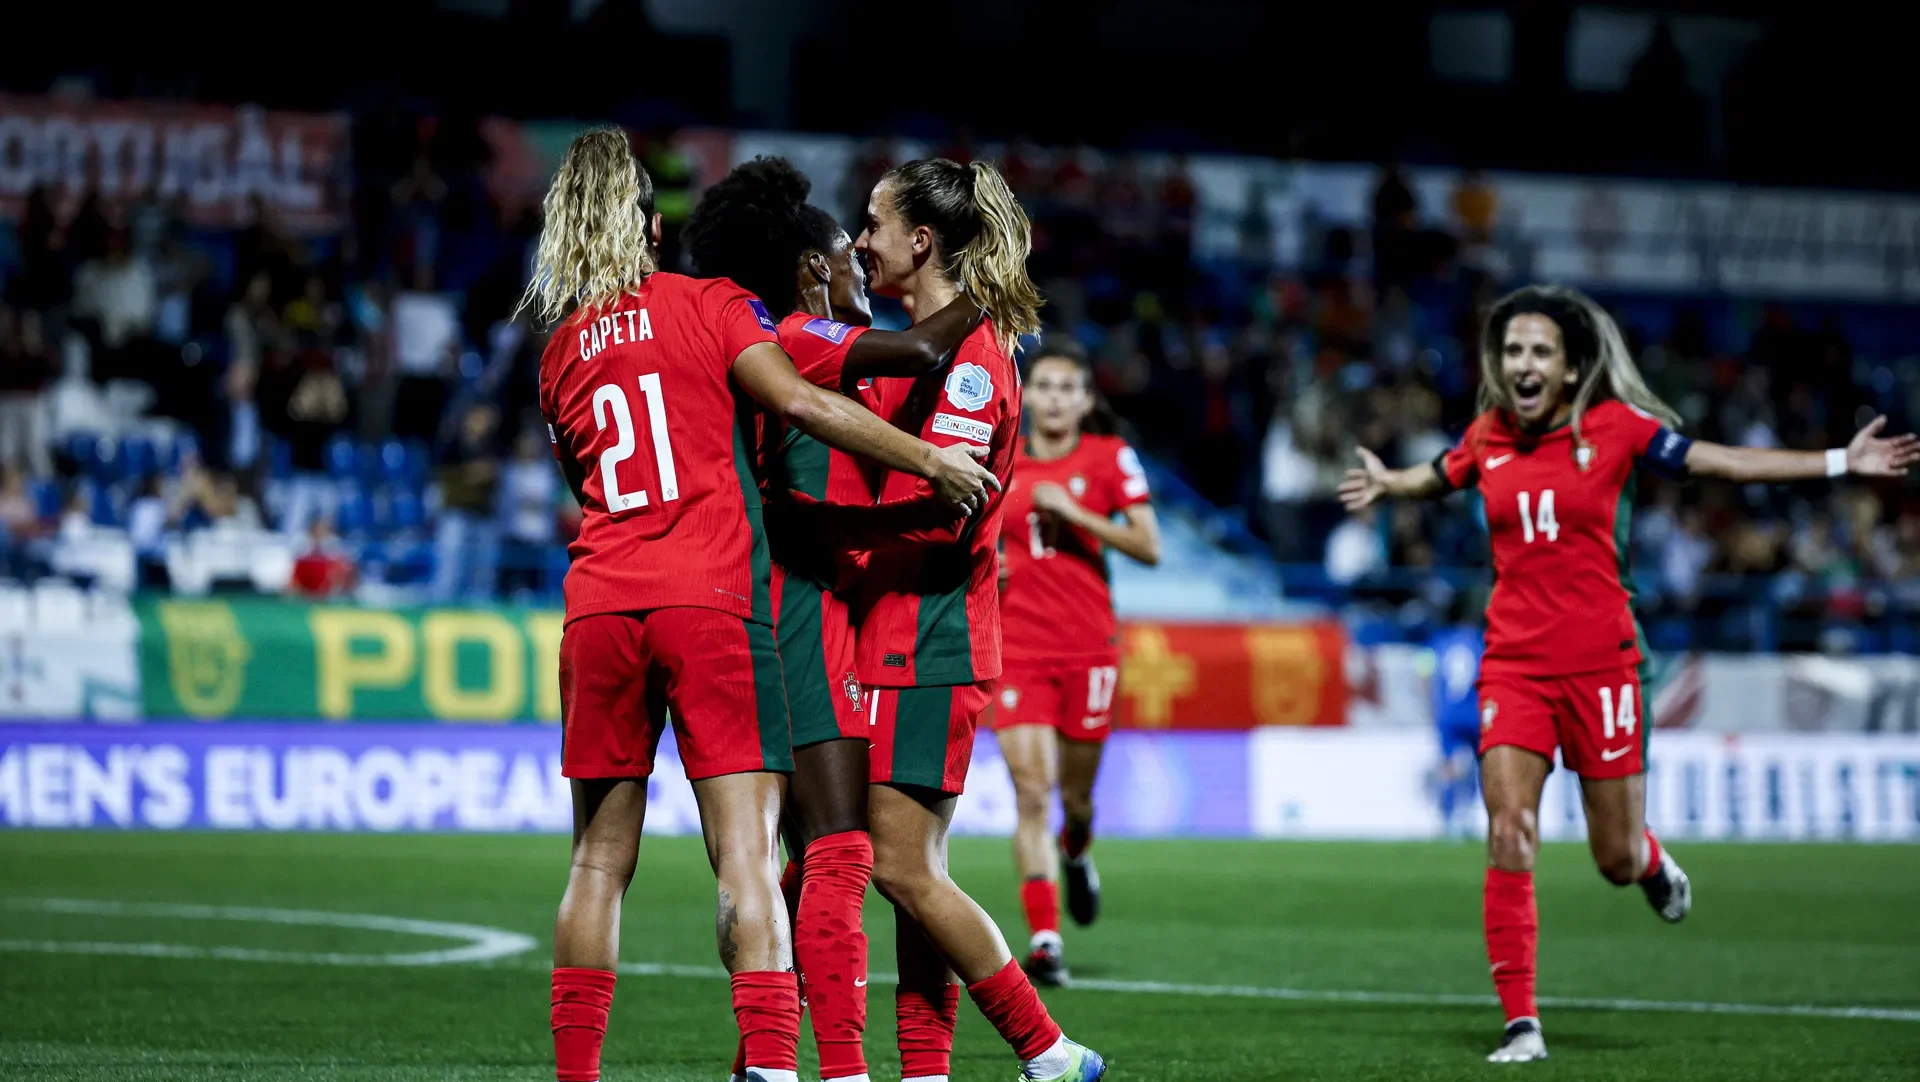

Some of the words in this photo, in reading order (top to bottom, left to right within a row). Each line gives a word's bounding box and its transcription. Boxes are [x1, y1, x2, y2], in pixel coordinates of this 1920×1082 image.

[579, 307, 654, 362] CAPETA
[592, 372, 679, 513] 21
[934, 418, 990, 438] FOUNDATION
[1516, 489, 1560, 544] 14
[1598, 684, 1637, 739] 14
